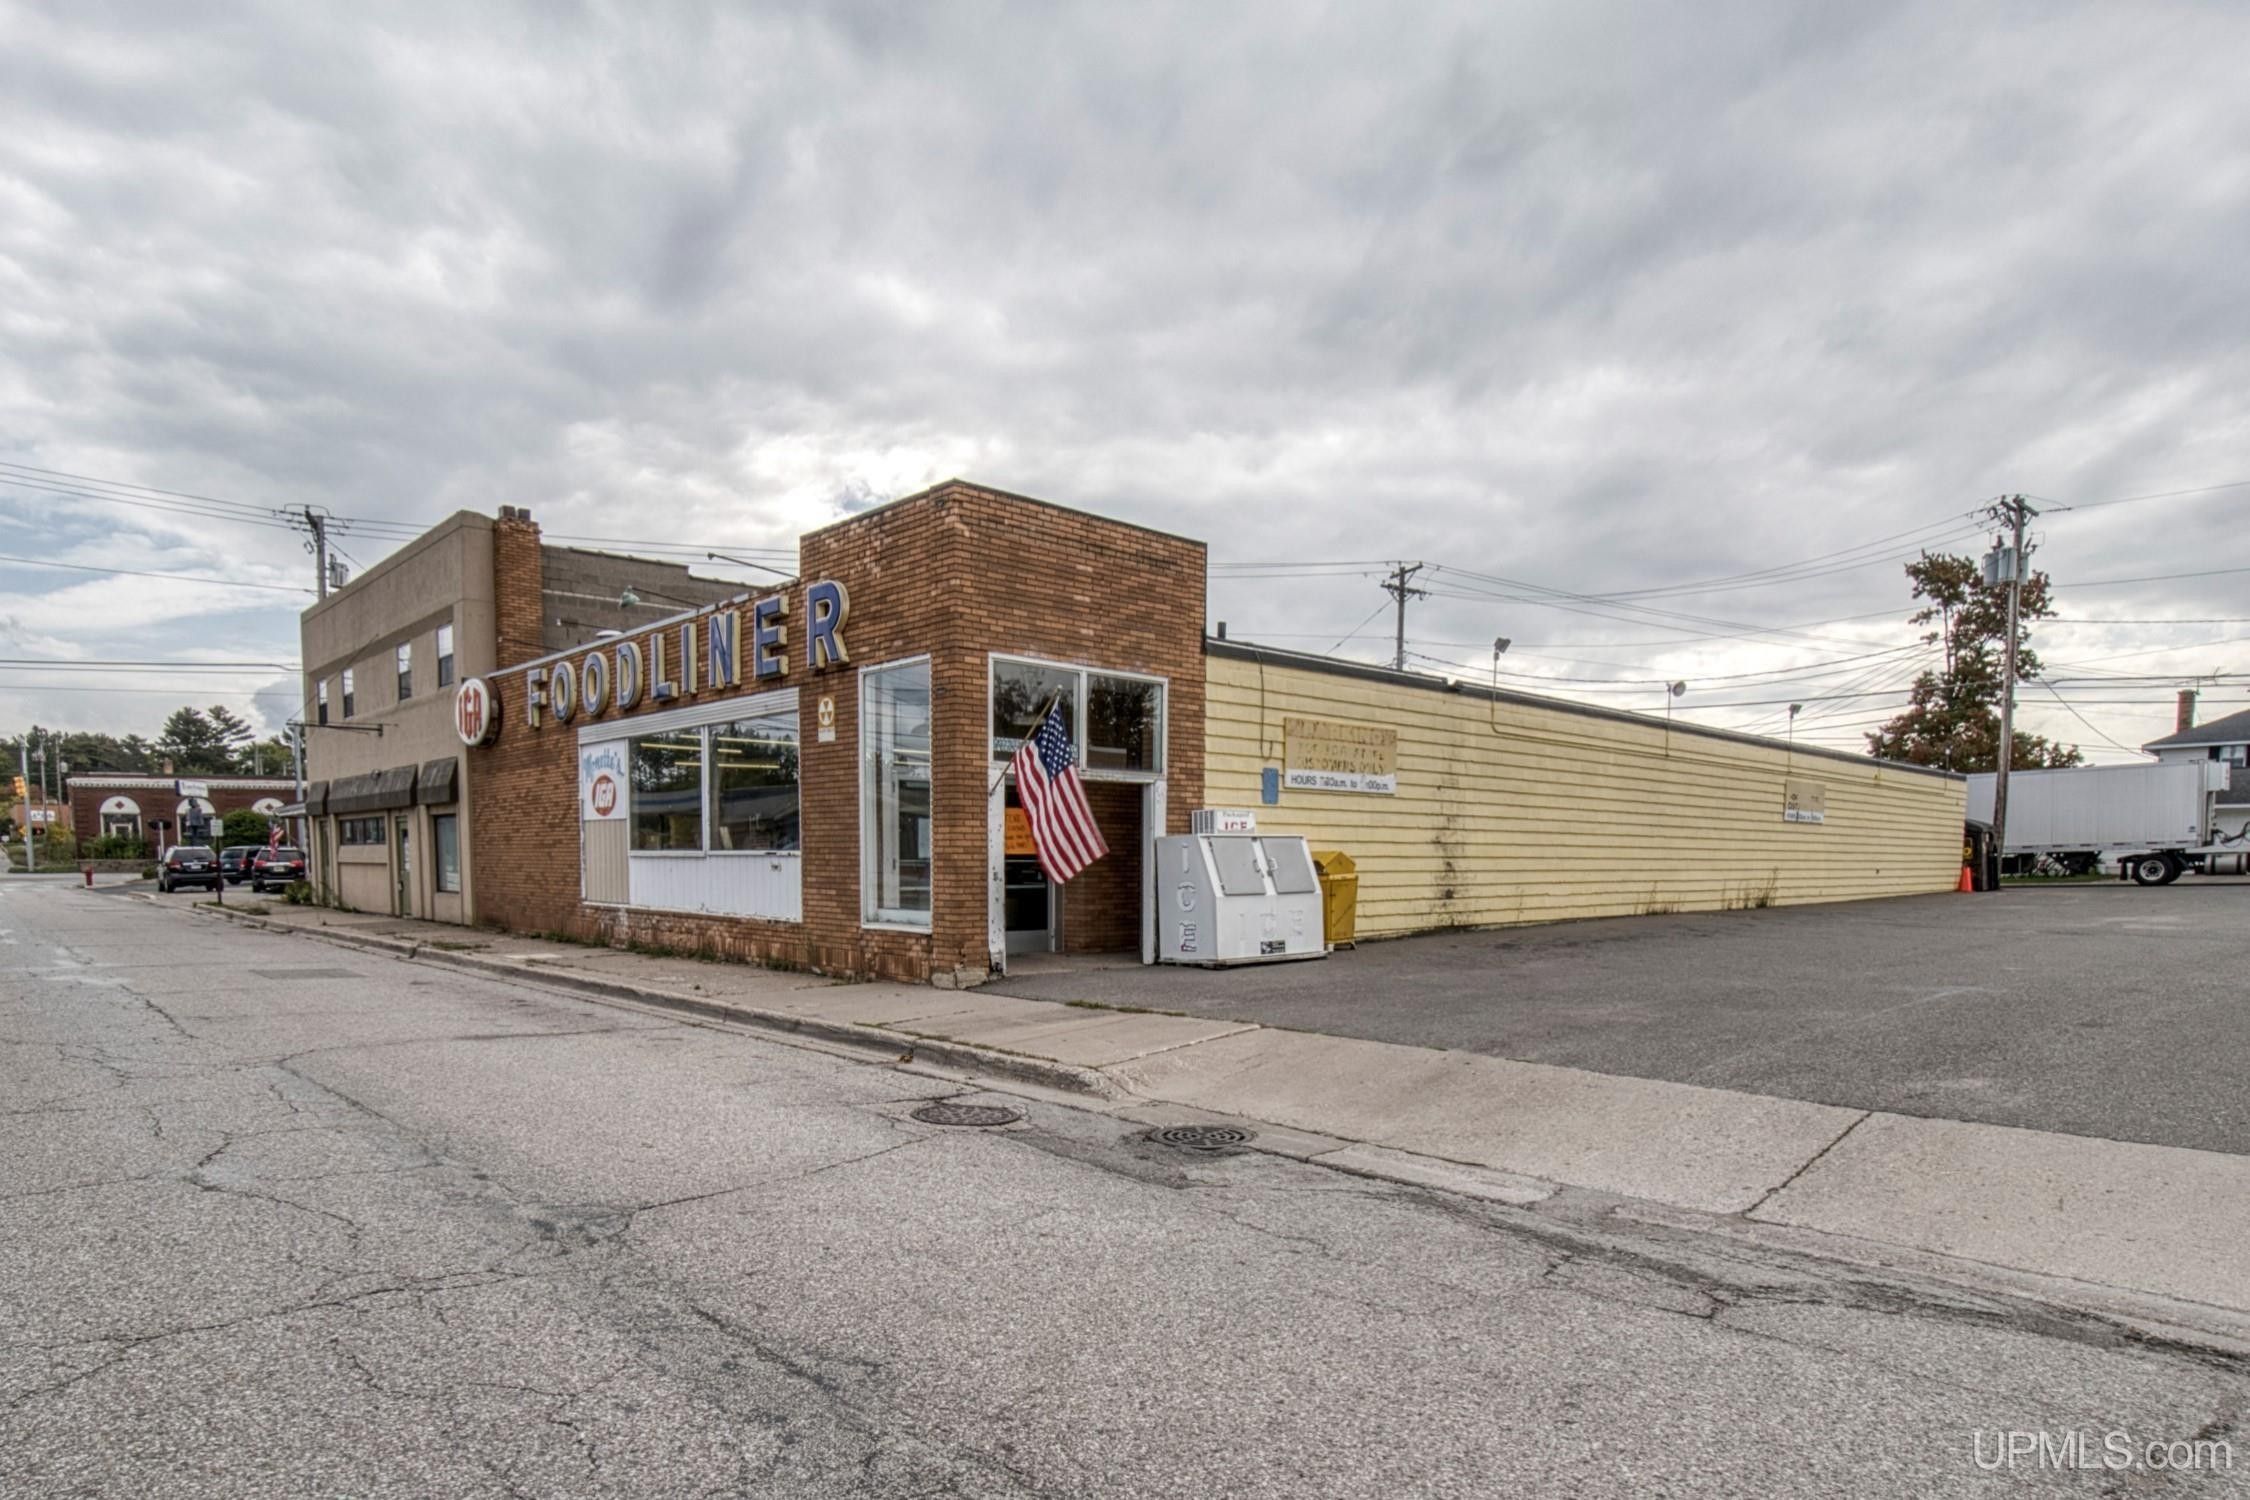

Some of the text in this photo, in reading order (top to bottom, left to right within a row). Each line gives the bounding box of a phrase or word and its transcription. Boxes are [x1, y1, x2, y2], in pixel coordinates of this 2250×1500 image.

[527, 579, 850, 728] FOODLINER
[459, 686, 482, 739] IGA
[1290, 774, 1317, 786] HOURS
